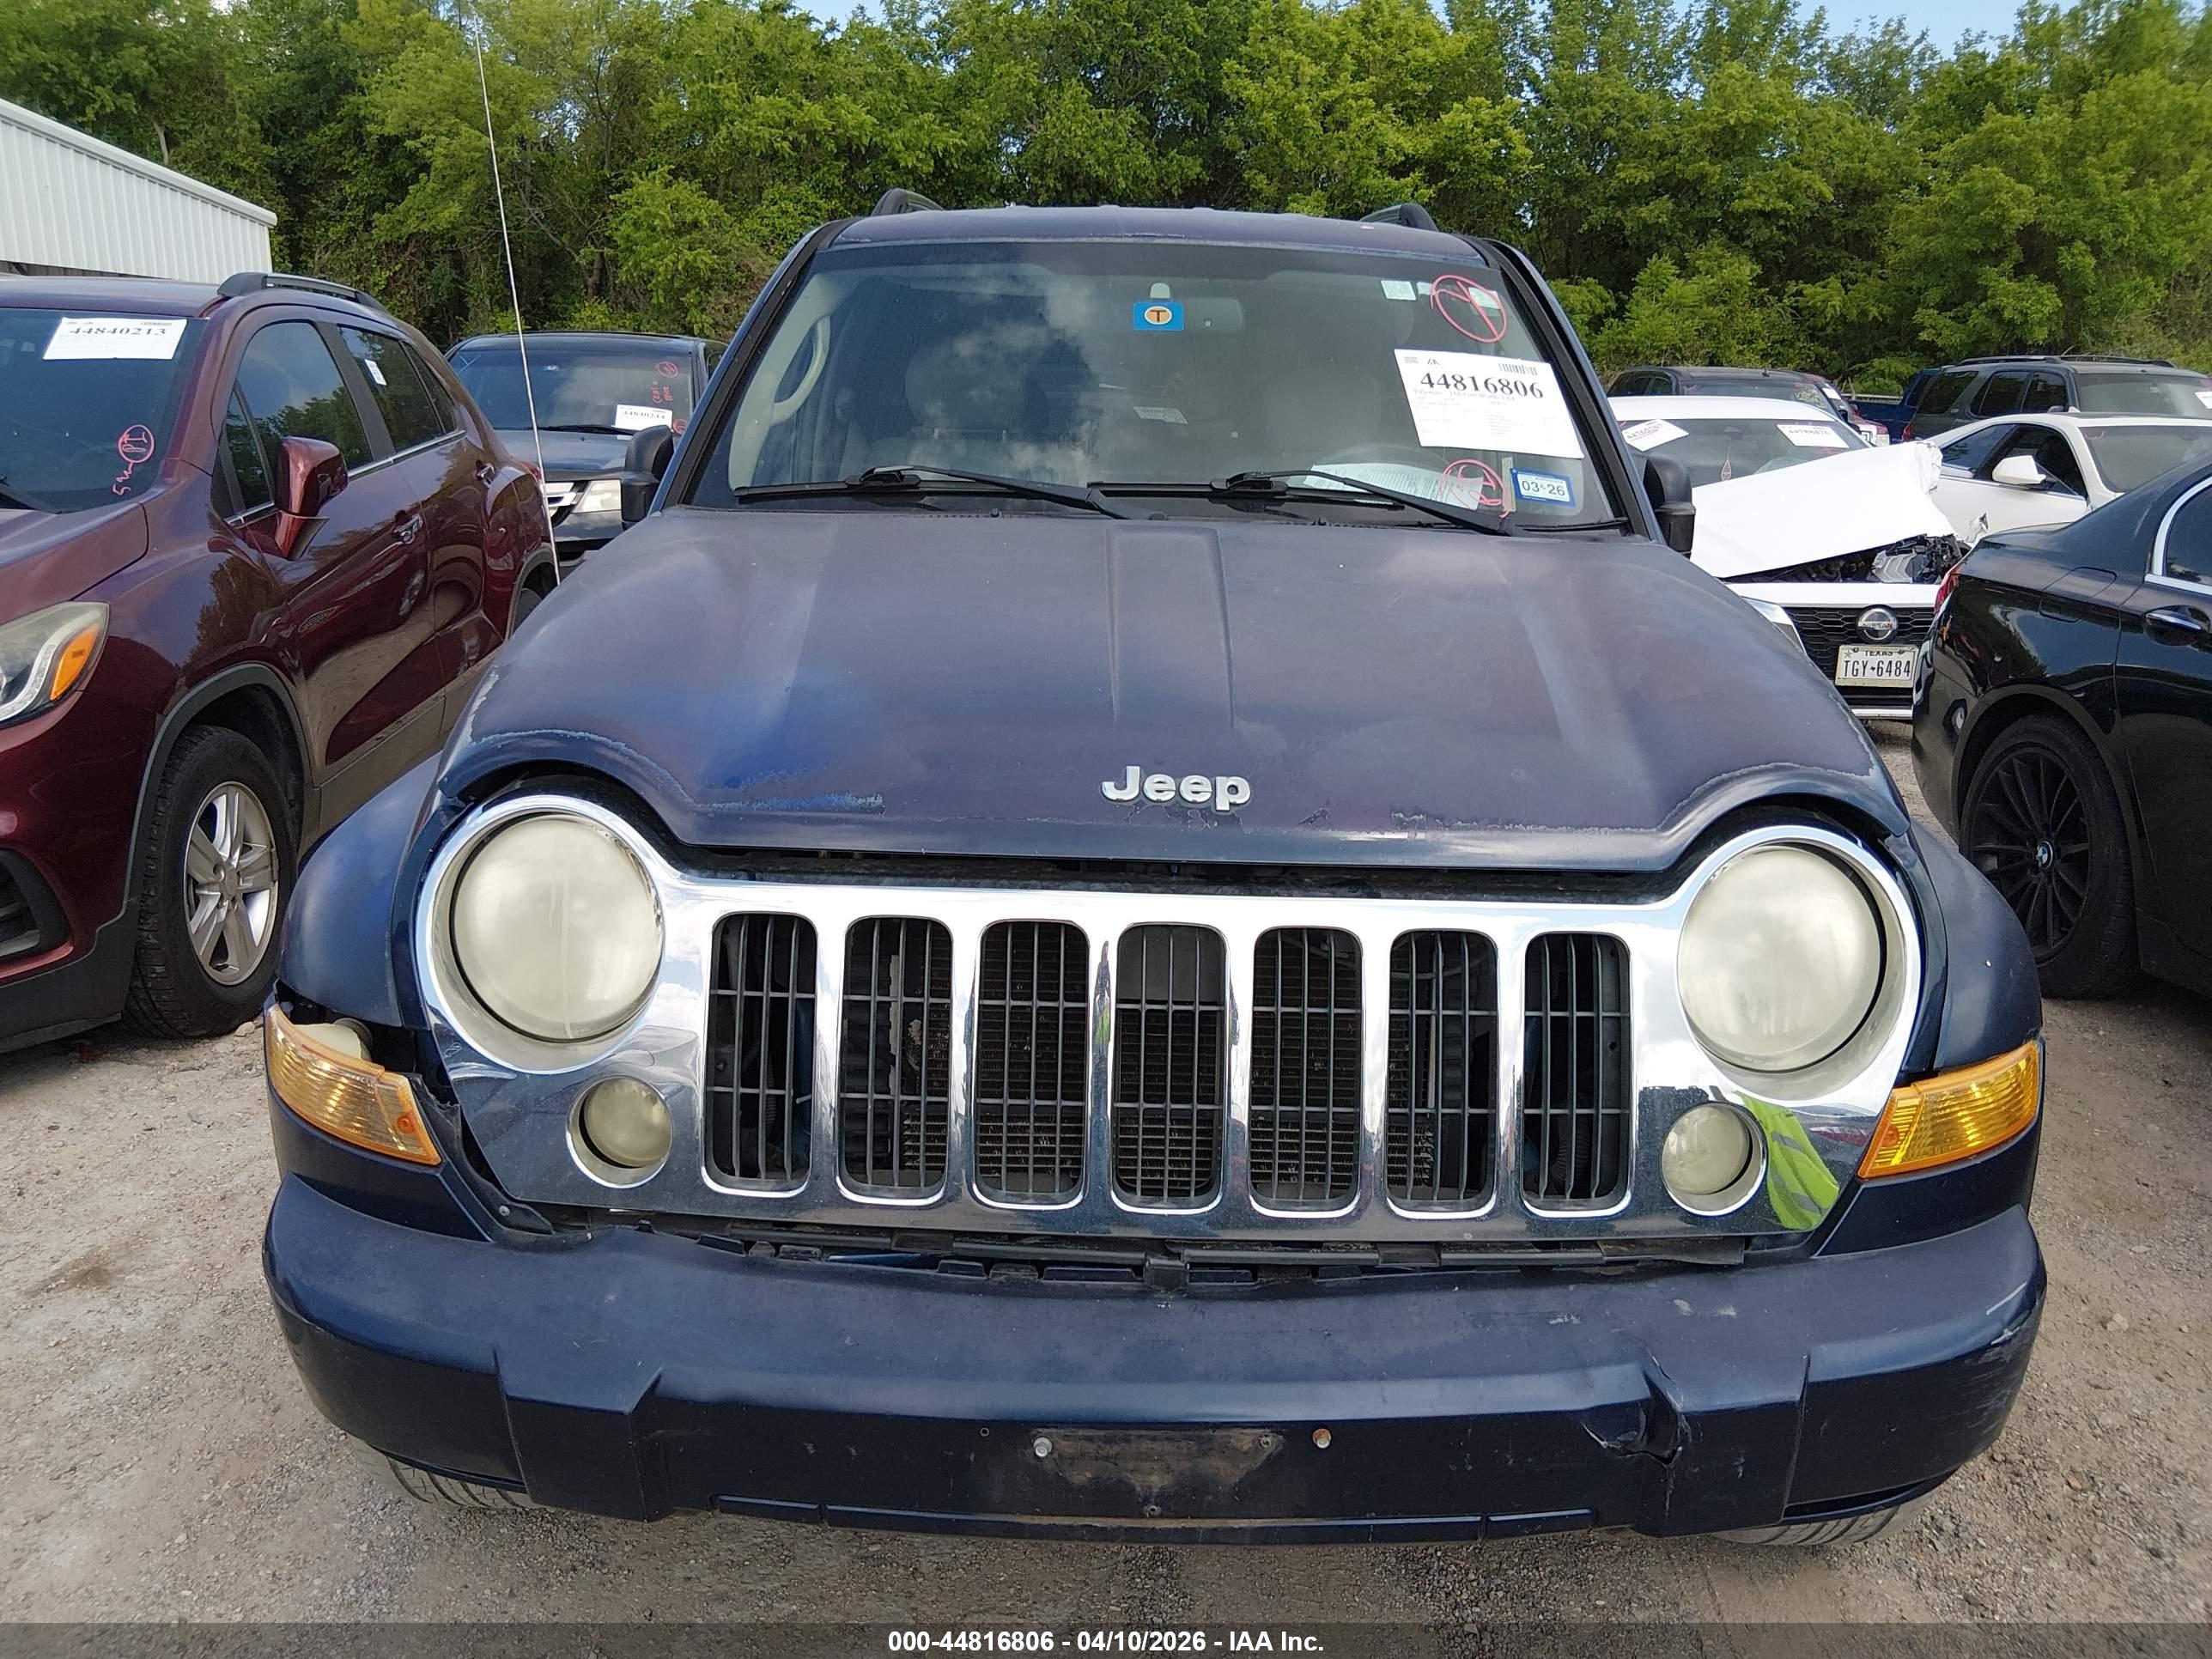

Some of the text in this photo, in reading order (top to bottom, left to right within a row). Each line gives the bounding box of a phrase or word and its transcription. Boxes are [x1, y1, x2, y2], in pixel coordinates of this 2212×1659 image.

[69, 327, 167, 336] 44840213
[1419, 372, 1544, 399] 44816806
[1101, 764, 1251, 811] Jeep
